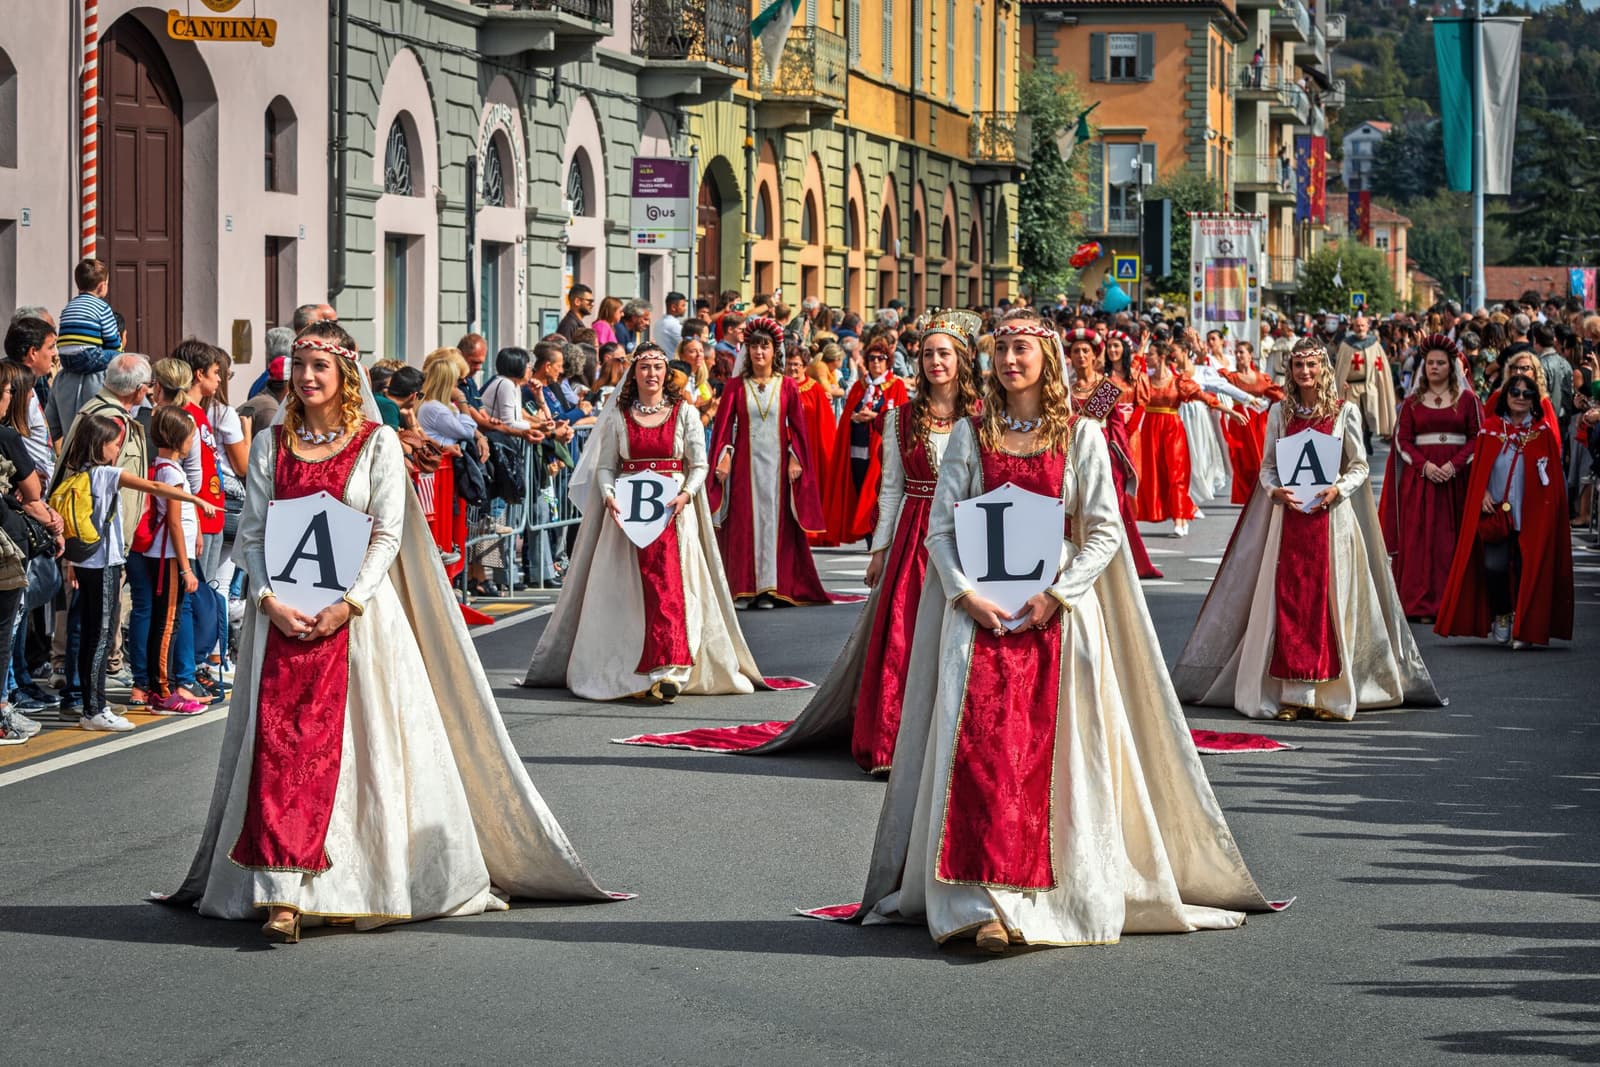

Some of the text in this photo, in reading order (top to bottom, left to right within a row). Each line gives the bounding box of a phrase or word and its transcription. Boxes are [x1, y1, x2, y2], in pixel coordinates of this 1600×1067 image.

[172, 19, 272, 38] CANTINA
[1284, 438, 1332, 486] A
[624, 480, 665, 522] B
[271, 510, 347, 592] A
[975, 502, 1045, 582] L
